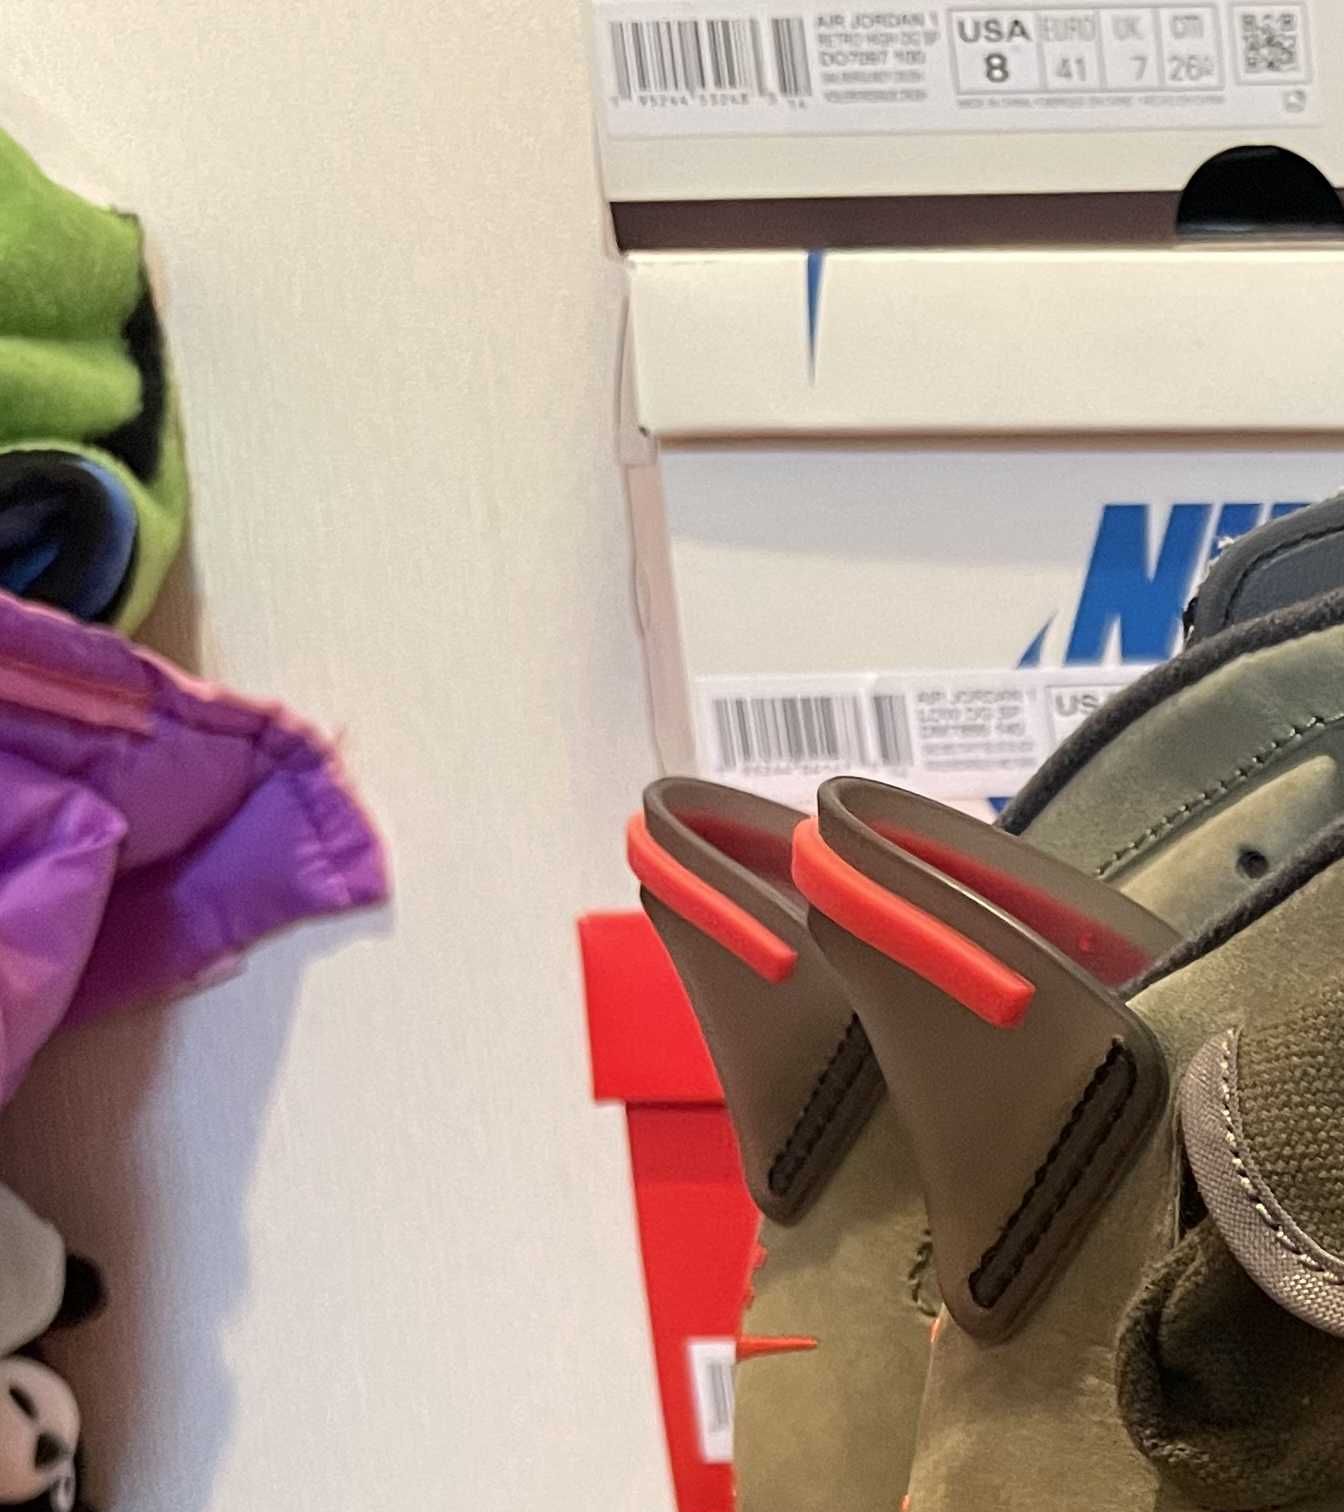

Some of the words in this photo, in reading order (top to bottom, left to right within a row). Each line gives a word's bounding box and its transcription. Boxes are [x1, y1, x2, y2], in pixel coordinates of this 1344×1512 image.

[957, 17, 1032, 44] USA
[984, 52, 1011, 84] 8
[1055, 57, 1087, 82] 41
[1130, 55, 1148, 82] 7
[1055, 693, 1101, 717] US
